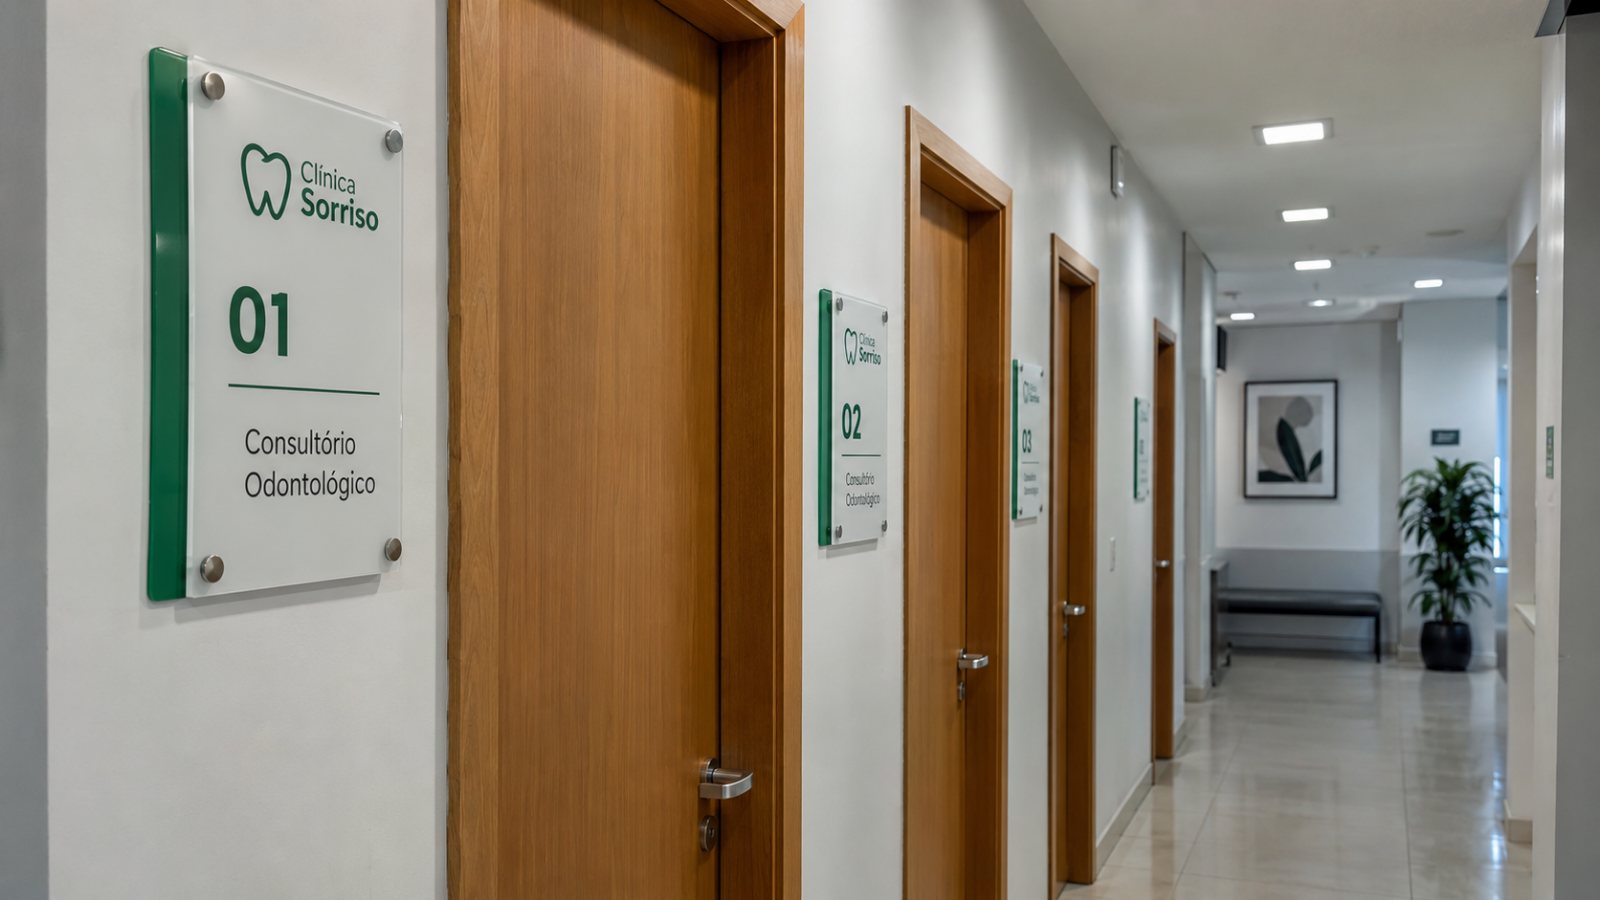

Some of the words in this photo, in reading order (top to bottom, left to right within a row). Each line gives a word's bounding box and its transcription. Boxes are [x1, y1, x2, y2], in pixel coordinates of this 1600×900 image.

[301, 160, 356, 195] Clínica
[300, 187, 379, 231] Sorriso
[229, 285, 288, 357] 01
[859, 346, 882, 366] Sorriso
[841, 403, 862, 440] 02
[245, 428, 356, 455] Consultório
[1022, 428, 1032, 453] 03
[244, 470, 376, 501] Odontológico
